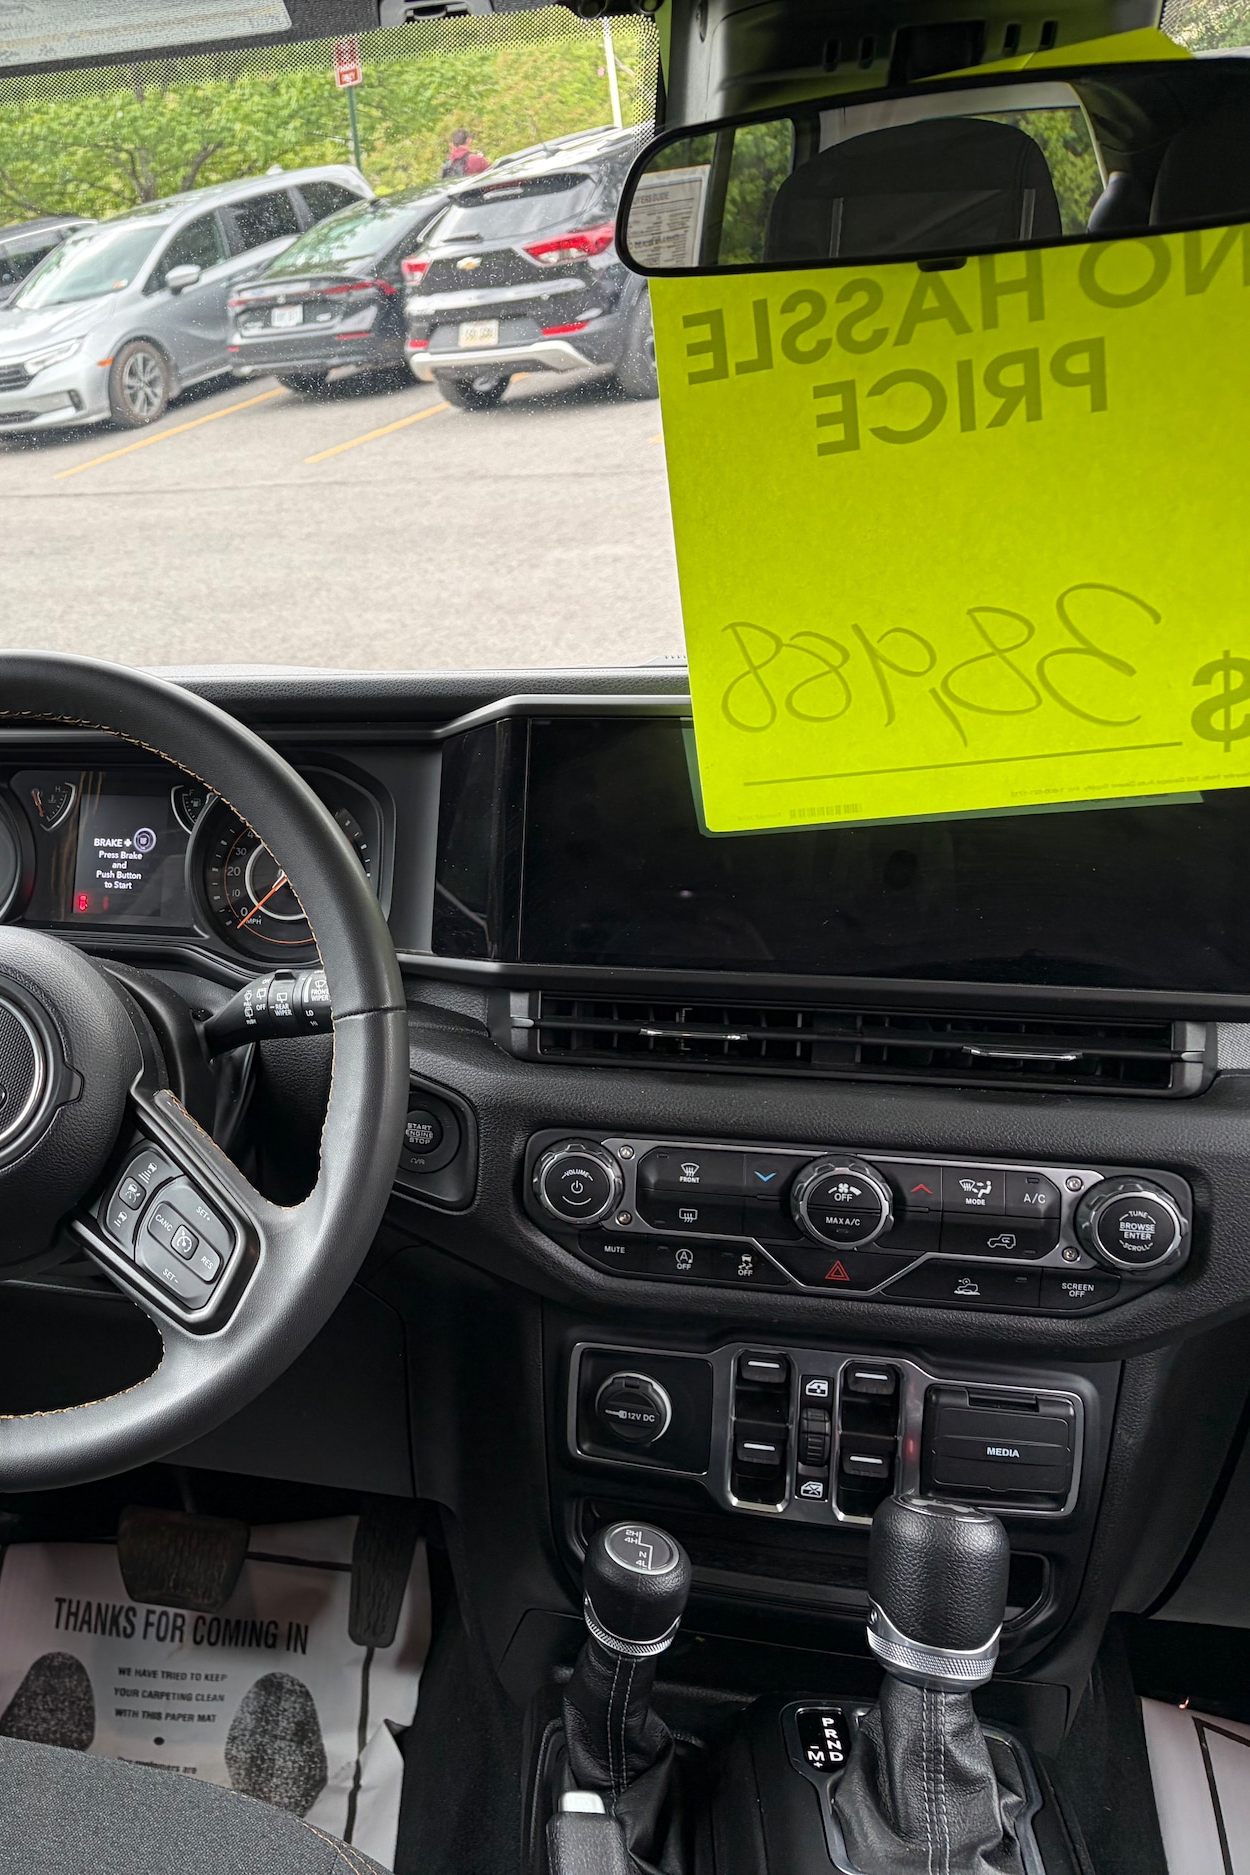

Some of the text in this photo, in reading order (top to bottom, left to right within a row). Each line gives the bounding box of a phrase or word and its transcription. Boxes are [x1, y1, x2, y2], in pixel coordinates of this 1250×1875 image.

[94, 838, 123, 847] BRAKE
[99, 851, 143, 860] Press Brake
[235, 847, 246, 856] 30
[112, 861, 127, 869] and
[96, 870, 142, 880] Push Button
[227, 866, 241, 876] 20
[114, 881, 133, 889] Start
[232, 889, 240, 897] 10
[240, 907, 248, 916] 0
[407, 1122, 432, 1131] START
[409, 1137, 431, 1145] STOP
[564, 1168, 590, 1178] VOLUME
[834, 1192, 853, 1202] OFF
[965, 1197, 986, 1206] MODE
[1023, 1193, 1046, 1204] A/C
[1128, 1210, 1148, 1219] TUNE
[155, 1214, 173, 1232] CANC
[825, 1216, 861, 1226] MAX A/C
[1119, 1221, 1155, 1232] BROWSE
[1124, 1231, 1152, 1240] ENTER
[604, 1245, 626, 1253] MUTE
[1121, 1241, 1151, 1252] SCROLL
[200, 1255, 214, 1270] RES
[676, 1262, 692, 1270] OFF
[1061, 1282, 1094, 1292] SCREEN
[1069, 1290, 1085, 1298] OFF
[627, 1412, 655, 1422] 12V DC
[986, 1446, 1020, 1458] MEDIA
[624, 1537, 639, 1545] 4H
[639, 1550, 647, 1558] N
[636, 1559, 648, 1568] 4L
[54, 1597, 309, 1655] THANKS FOR COMING IN
[118, 1666, 228, 1682] WE HAVE TRIED TO KEEP
[114, 1687, 225, 1702] YOUR CARPETING CLEAN
[115, 1707, 217, 1723] WITH THIS PAPER MAT
[822, 1717, 835, 1727] P
[824, 1729, 838, 1739] R
[826, 1740, 842, 1750] N
[807, 1751, 825, 1761] M
[829, 1752, 844, 1762] D
